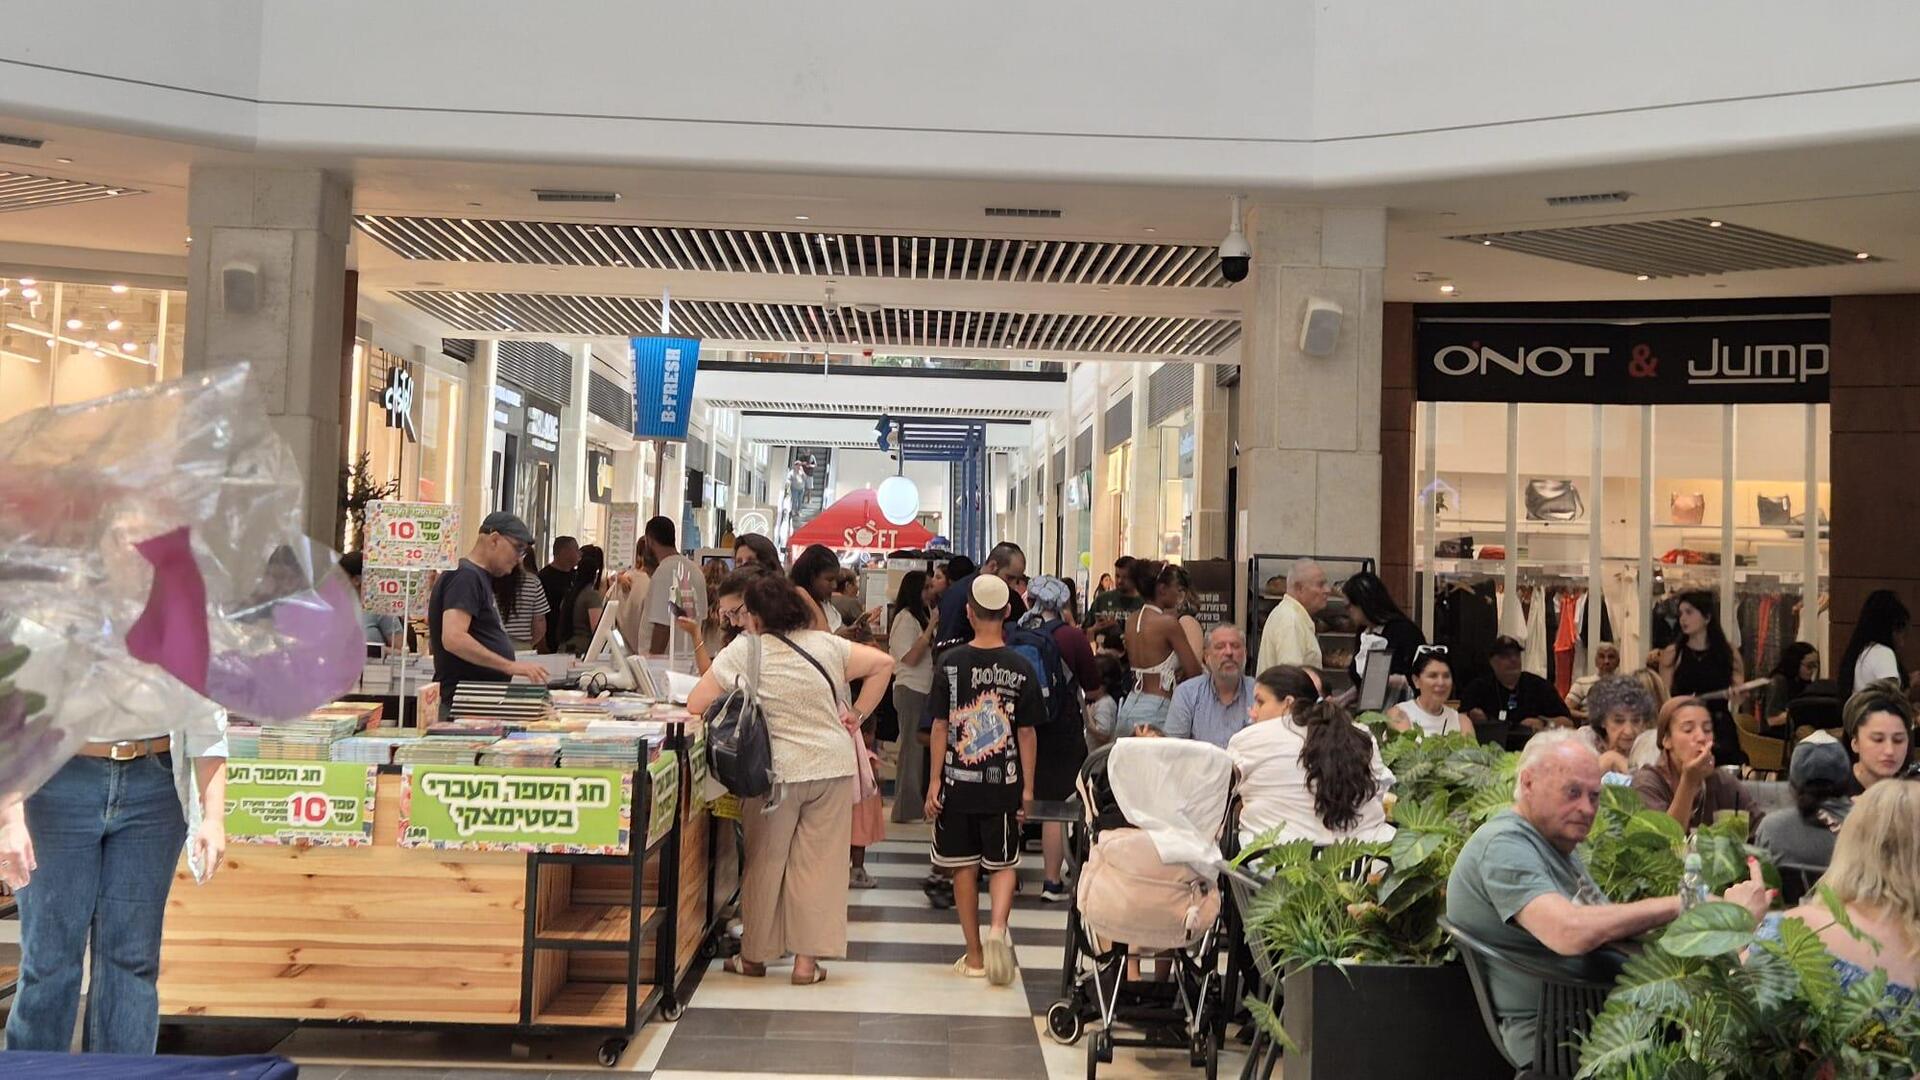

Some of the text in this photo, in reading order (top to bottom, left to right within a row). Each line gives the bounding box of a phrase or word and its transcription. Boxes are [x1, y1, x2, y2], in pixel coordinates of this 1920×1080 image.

[1628, 344, 1658, 378] &
[1688, 338, 1830, 384] Jump
[387, 521, 415, 539] 10
[417, 520, 440, 530] ספר
[422, 532, 440, 540] שני
[406, 550, 422, 559] 20
[378, 581, 398, 593] 10
[254, 768, 298, 781] הספר
[301, 769, 321, 782] חג
[428, 779, 605, 801] חג הספר העברי
[291, 796, 327, 822] 10
[330, 799, 356, 809] ספר
[335, 812, 355, 823] שני
[456, 806, 574, 830] בסטימצקי
